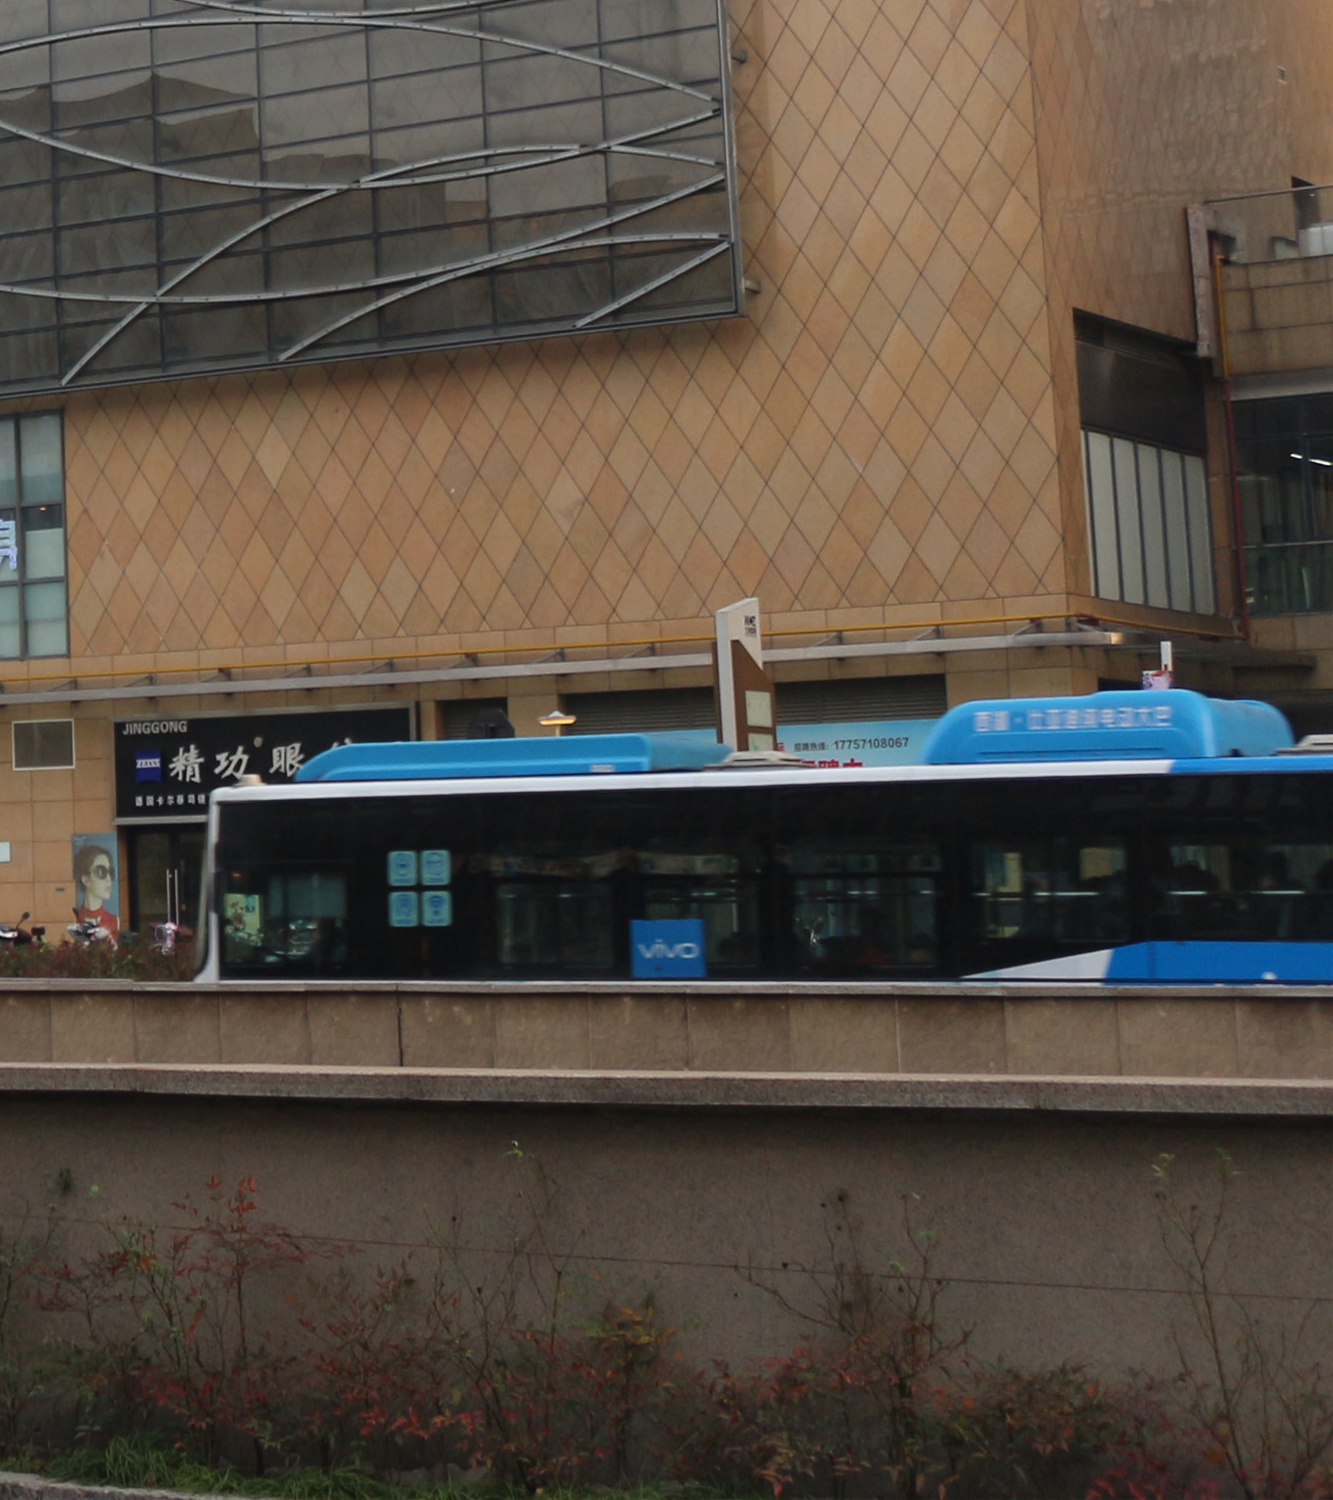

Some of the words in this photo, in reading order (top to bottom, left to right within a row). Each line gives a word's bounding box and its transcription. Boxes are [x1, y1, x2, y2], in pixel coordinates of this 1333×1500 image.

[122, 720, 188, 736] JINGGONG
[834, 736, 910, 751] 17757108067
[636, 938, 701, 959] vivo
